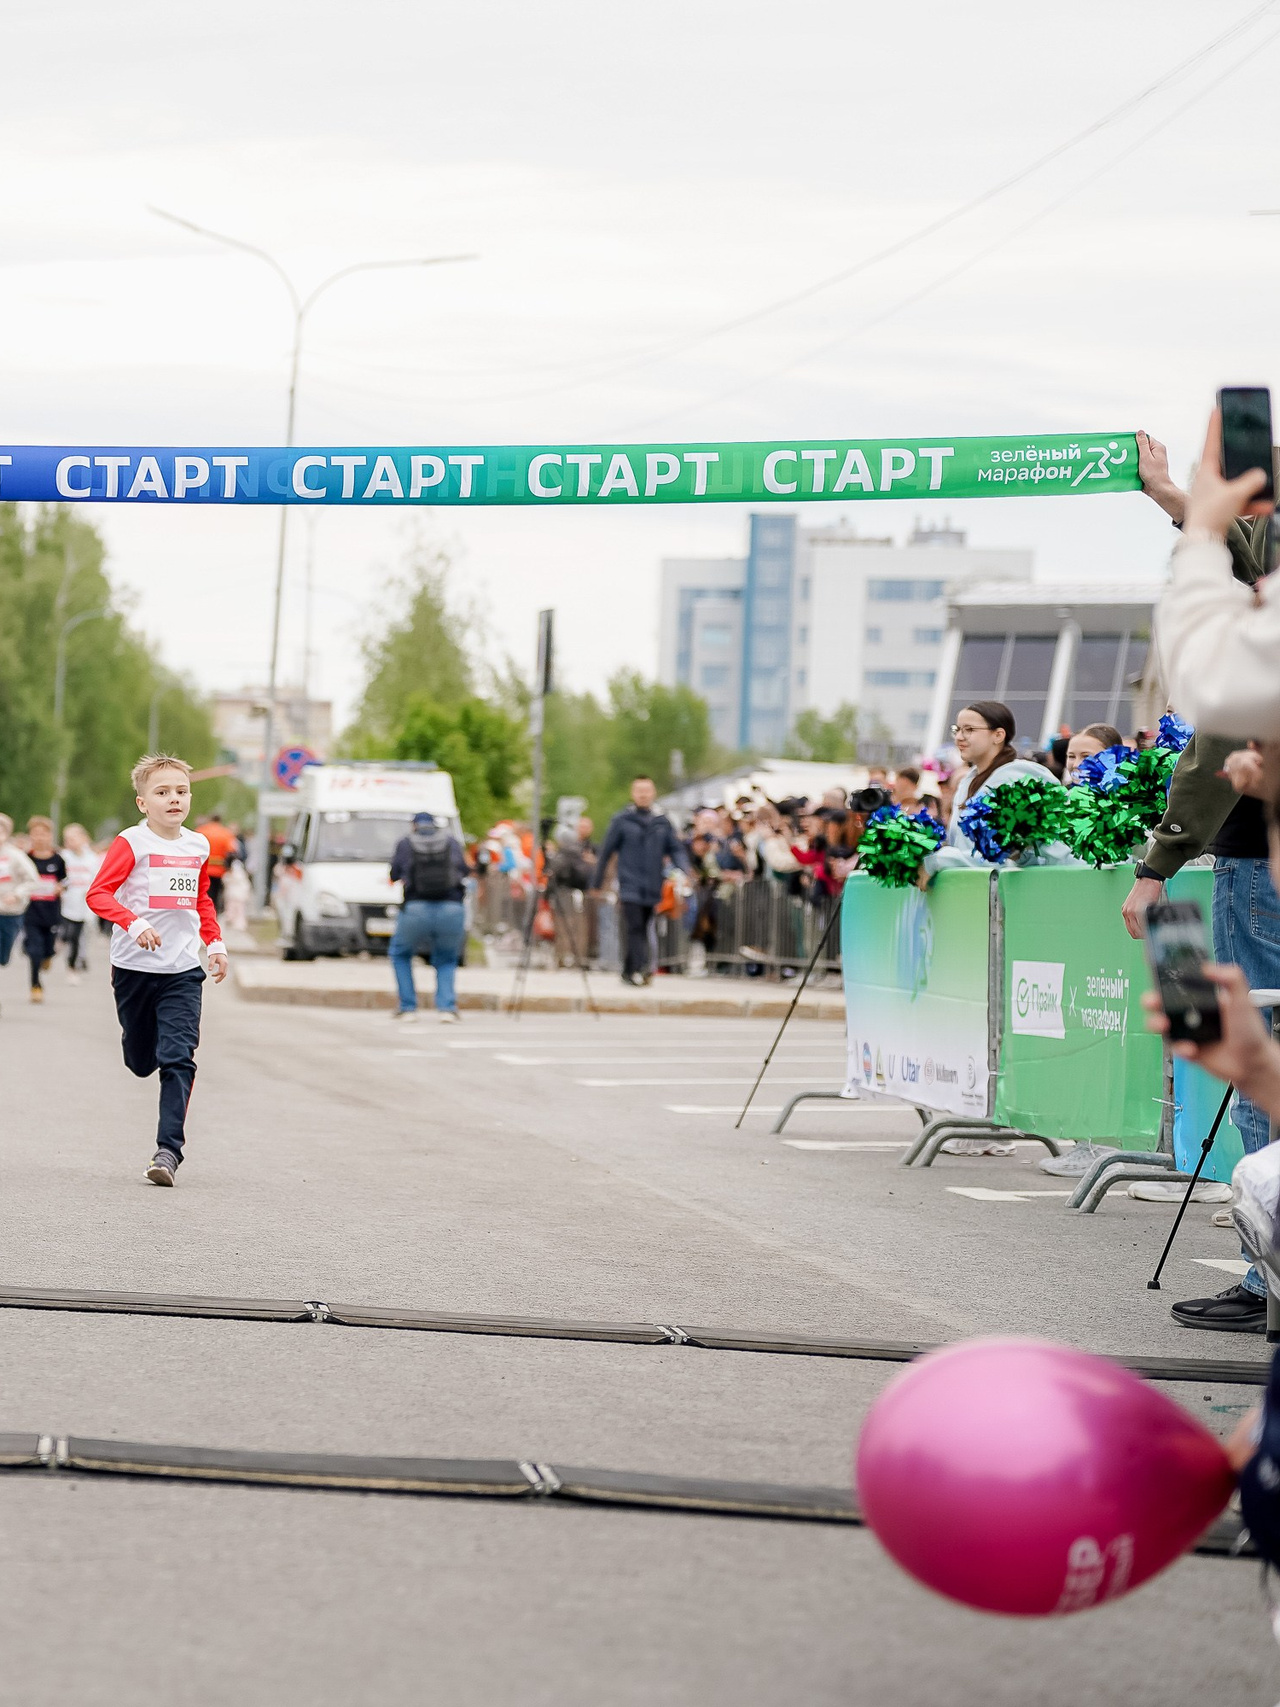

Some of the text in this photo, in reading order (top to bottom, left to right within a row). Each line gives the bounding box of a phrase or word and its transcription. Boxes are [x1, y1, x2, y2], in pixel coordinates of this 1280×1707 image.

[990, 443, 1082, 463] зелёный
[55, 455, 249, 499] СТАРТ
[292, 454, 485, 499] СТАРТ
[527, 452, 720, 499] СТАРТ
[762, 446, 955, 494] СТАРТ
[977, 461, 1073, 485] марафон
[169, 877, 197, 892] 2882
[1086, 968, 1124, 999] зелёный
